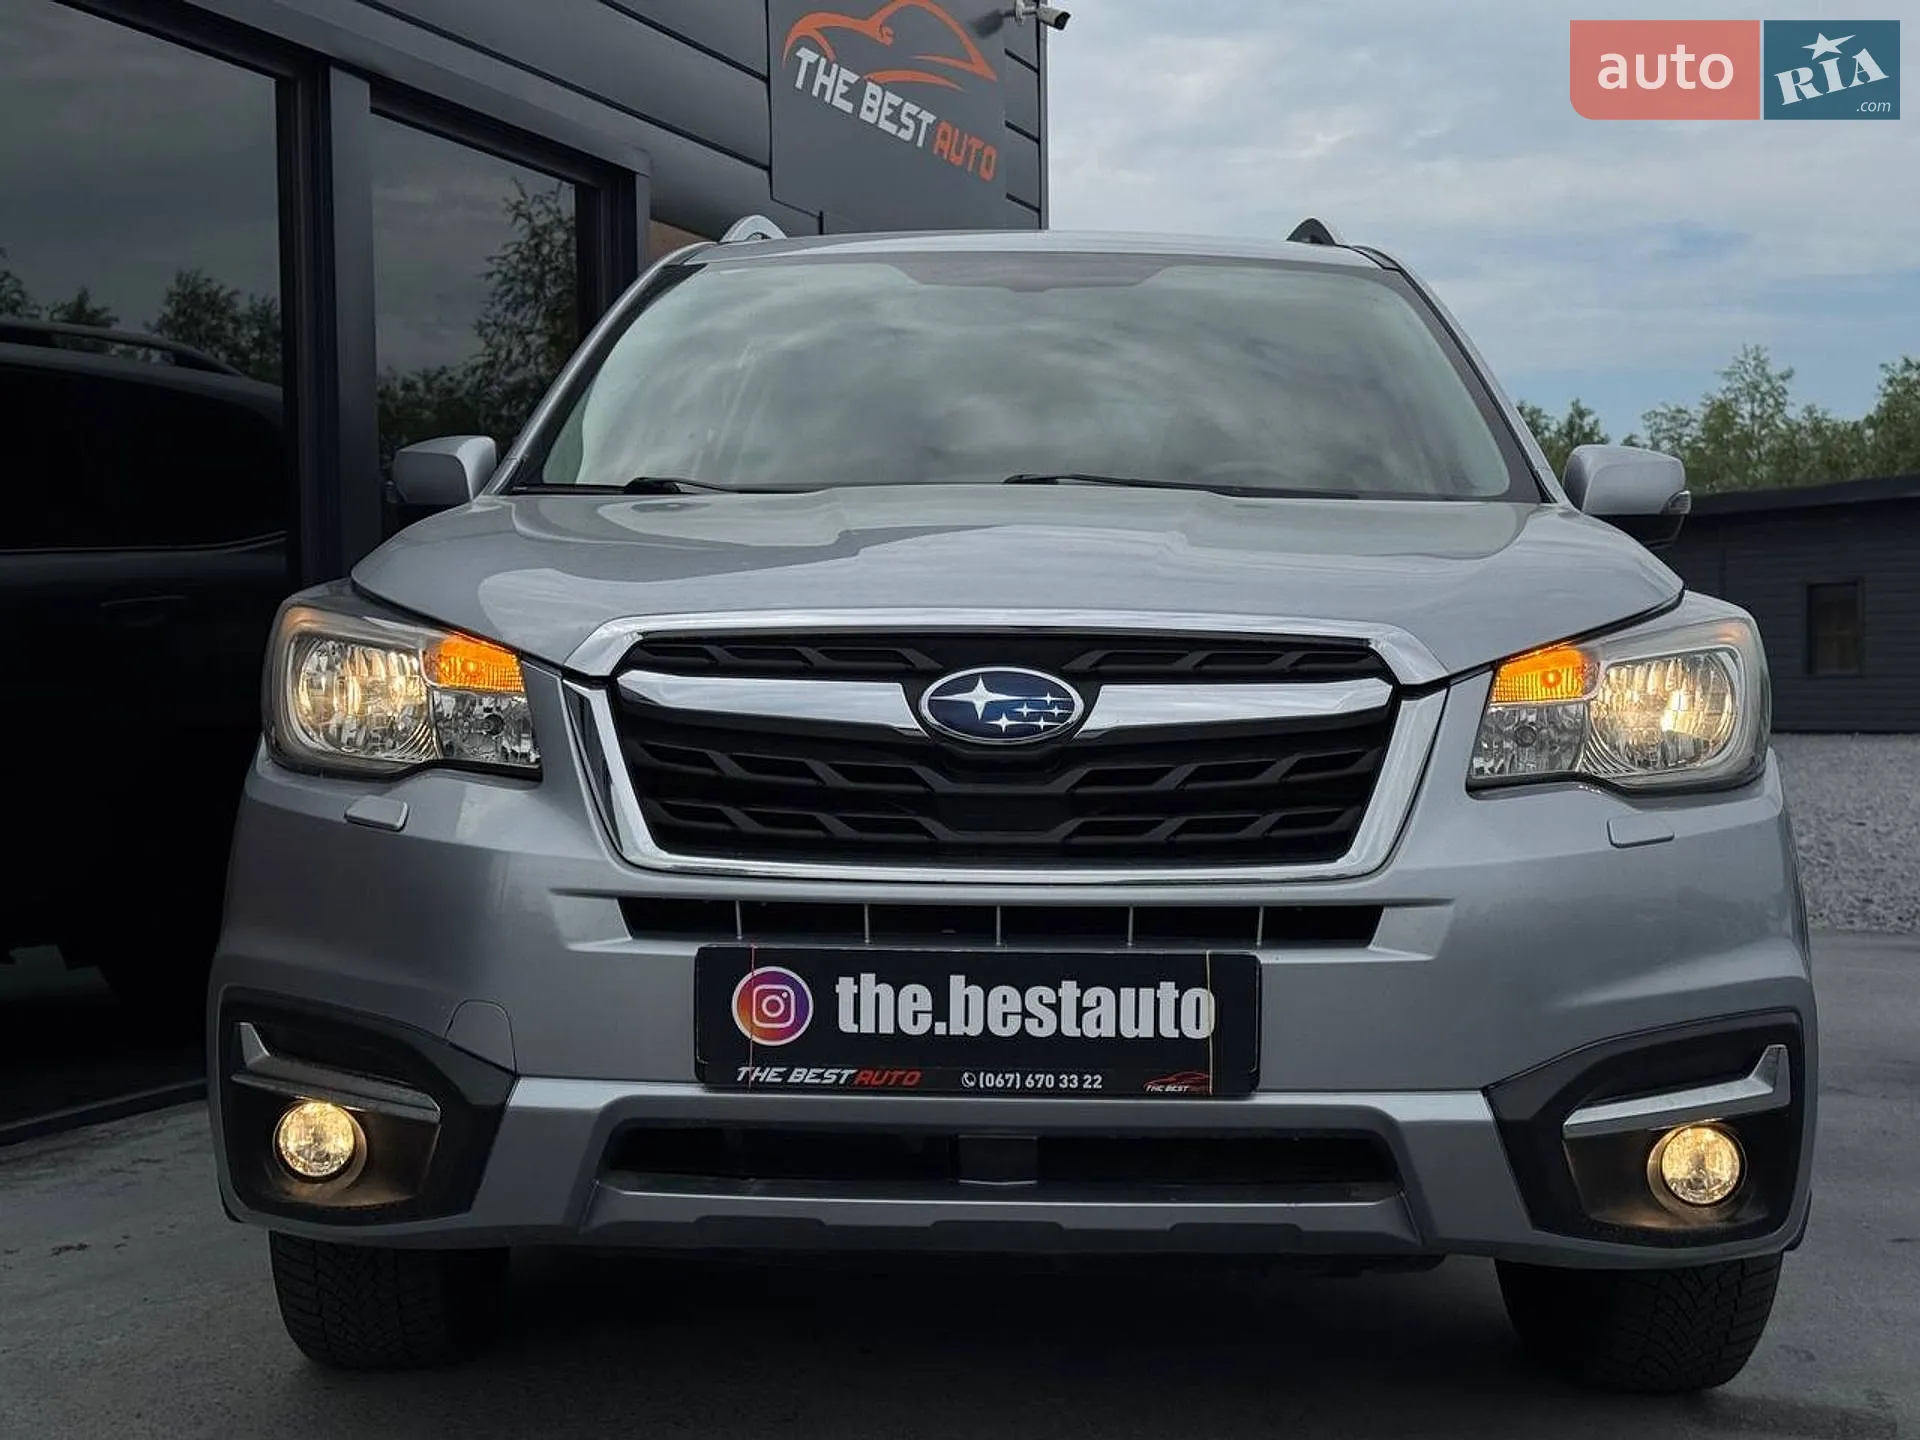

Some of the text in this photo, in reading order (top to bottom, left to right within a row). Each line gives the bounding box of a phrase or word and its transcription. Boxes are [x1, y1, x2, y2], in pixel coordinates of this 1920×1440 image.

[795, 46, 998, 182] THE BEST AUTO
[835, 972, 1216, 1040] the.bestauto
[736, 1066, 922, 1087] THE BEST AUTO
[979, 1071, 1103, 1089] (067) 670 33 22
